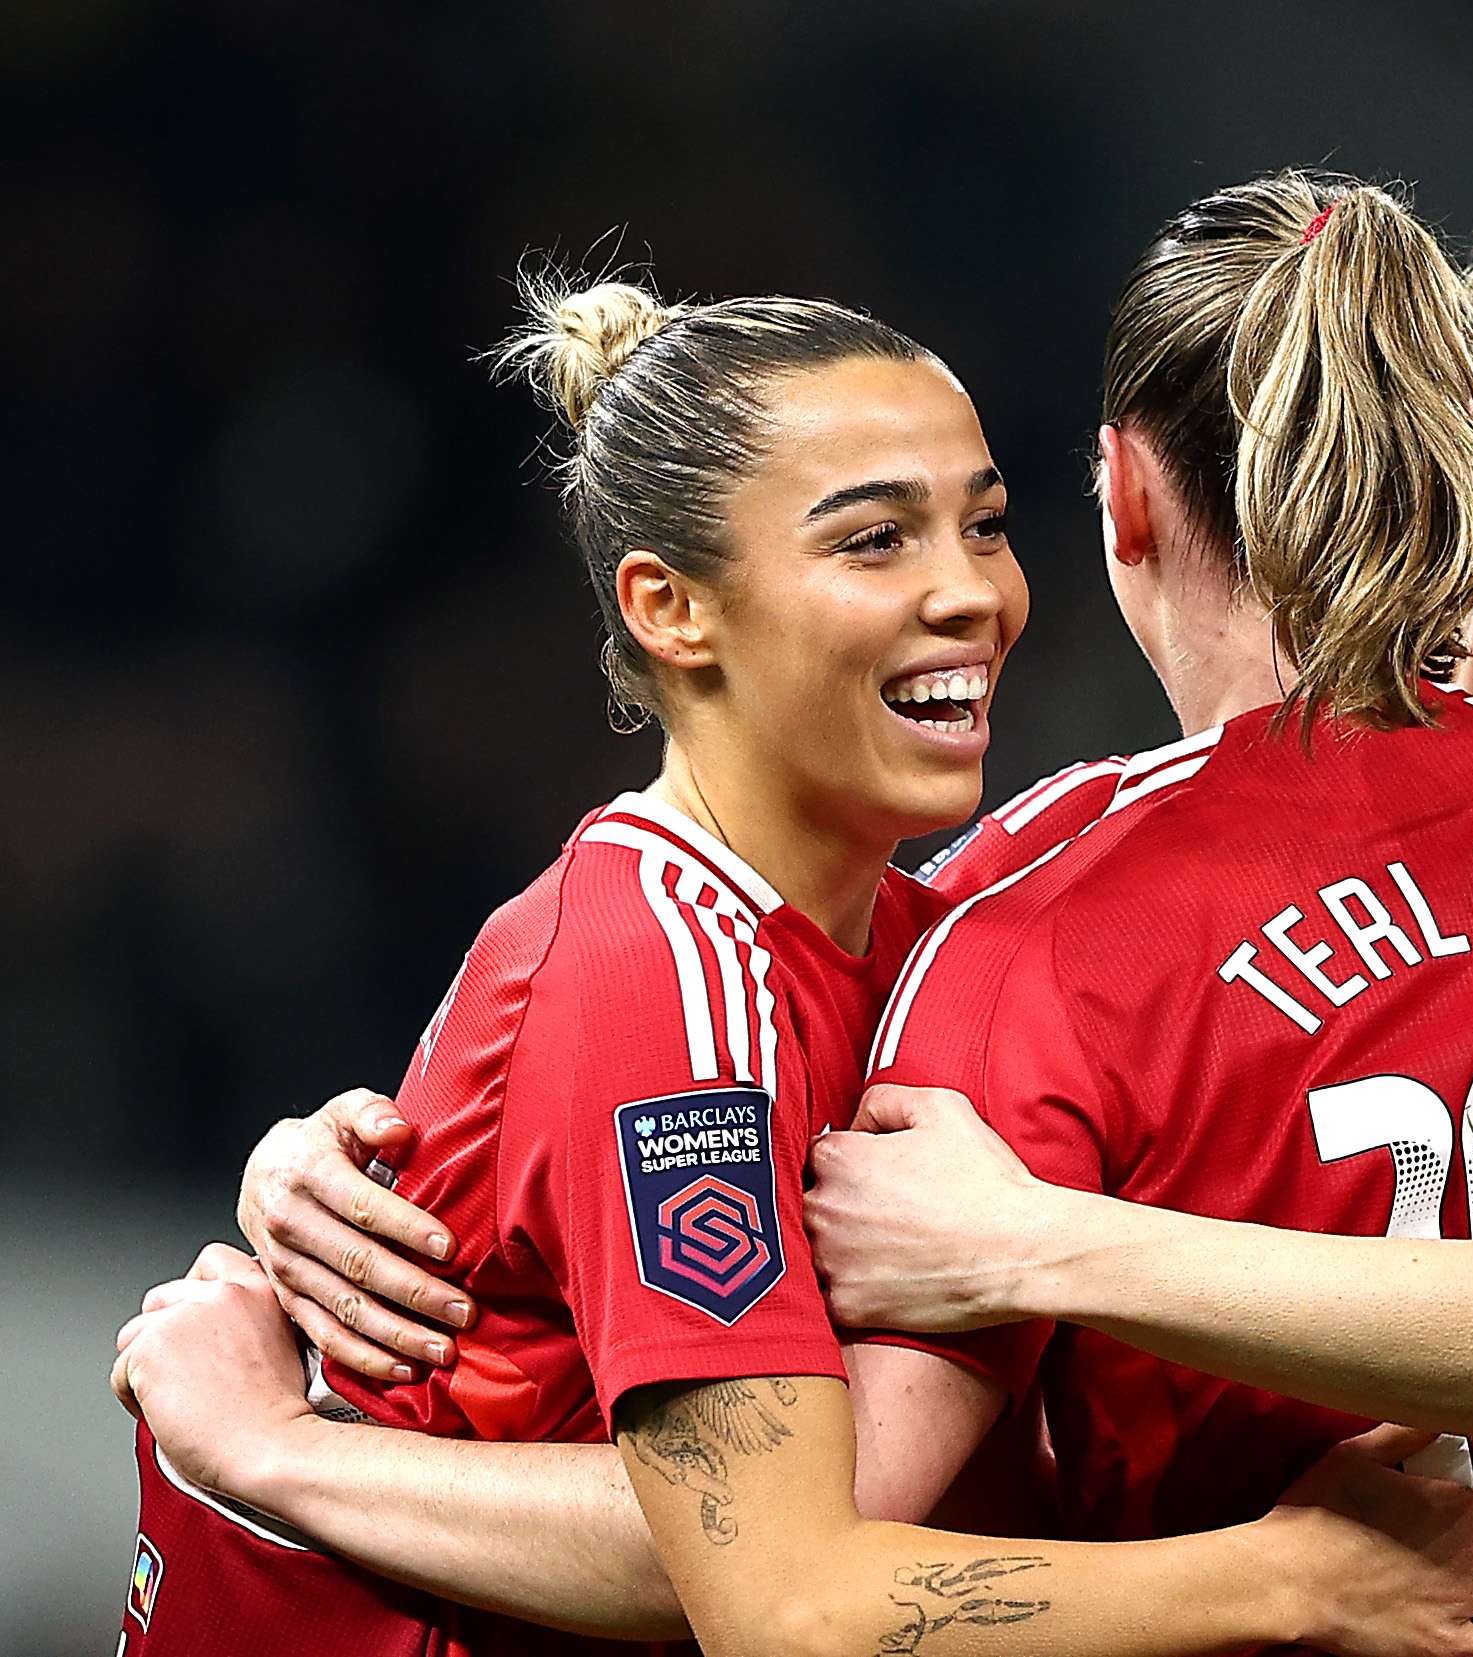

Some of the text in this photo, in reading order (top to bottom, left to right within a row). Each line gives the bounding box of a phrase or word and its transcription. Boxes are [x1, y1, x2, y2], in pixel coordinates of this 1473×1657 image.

[661, 1105, 756, 1132] BARCLAYS
[637, 1127, 759, 1158] WOMEN'S
[641, 1148, 761, 1173] SUPER LEAGUE
